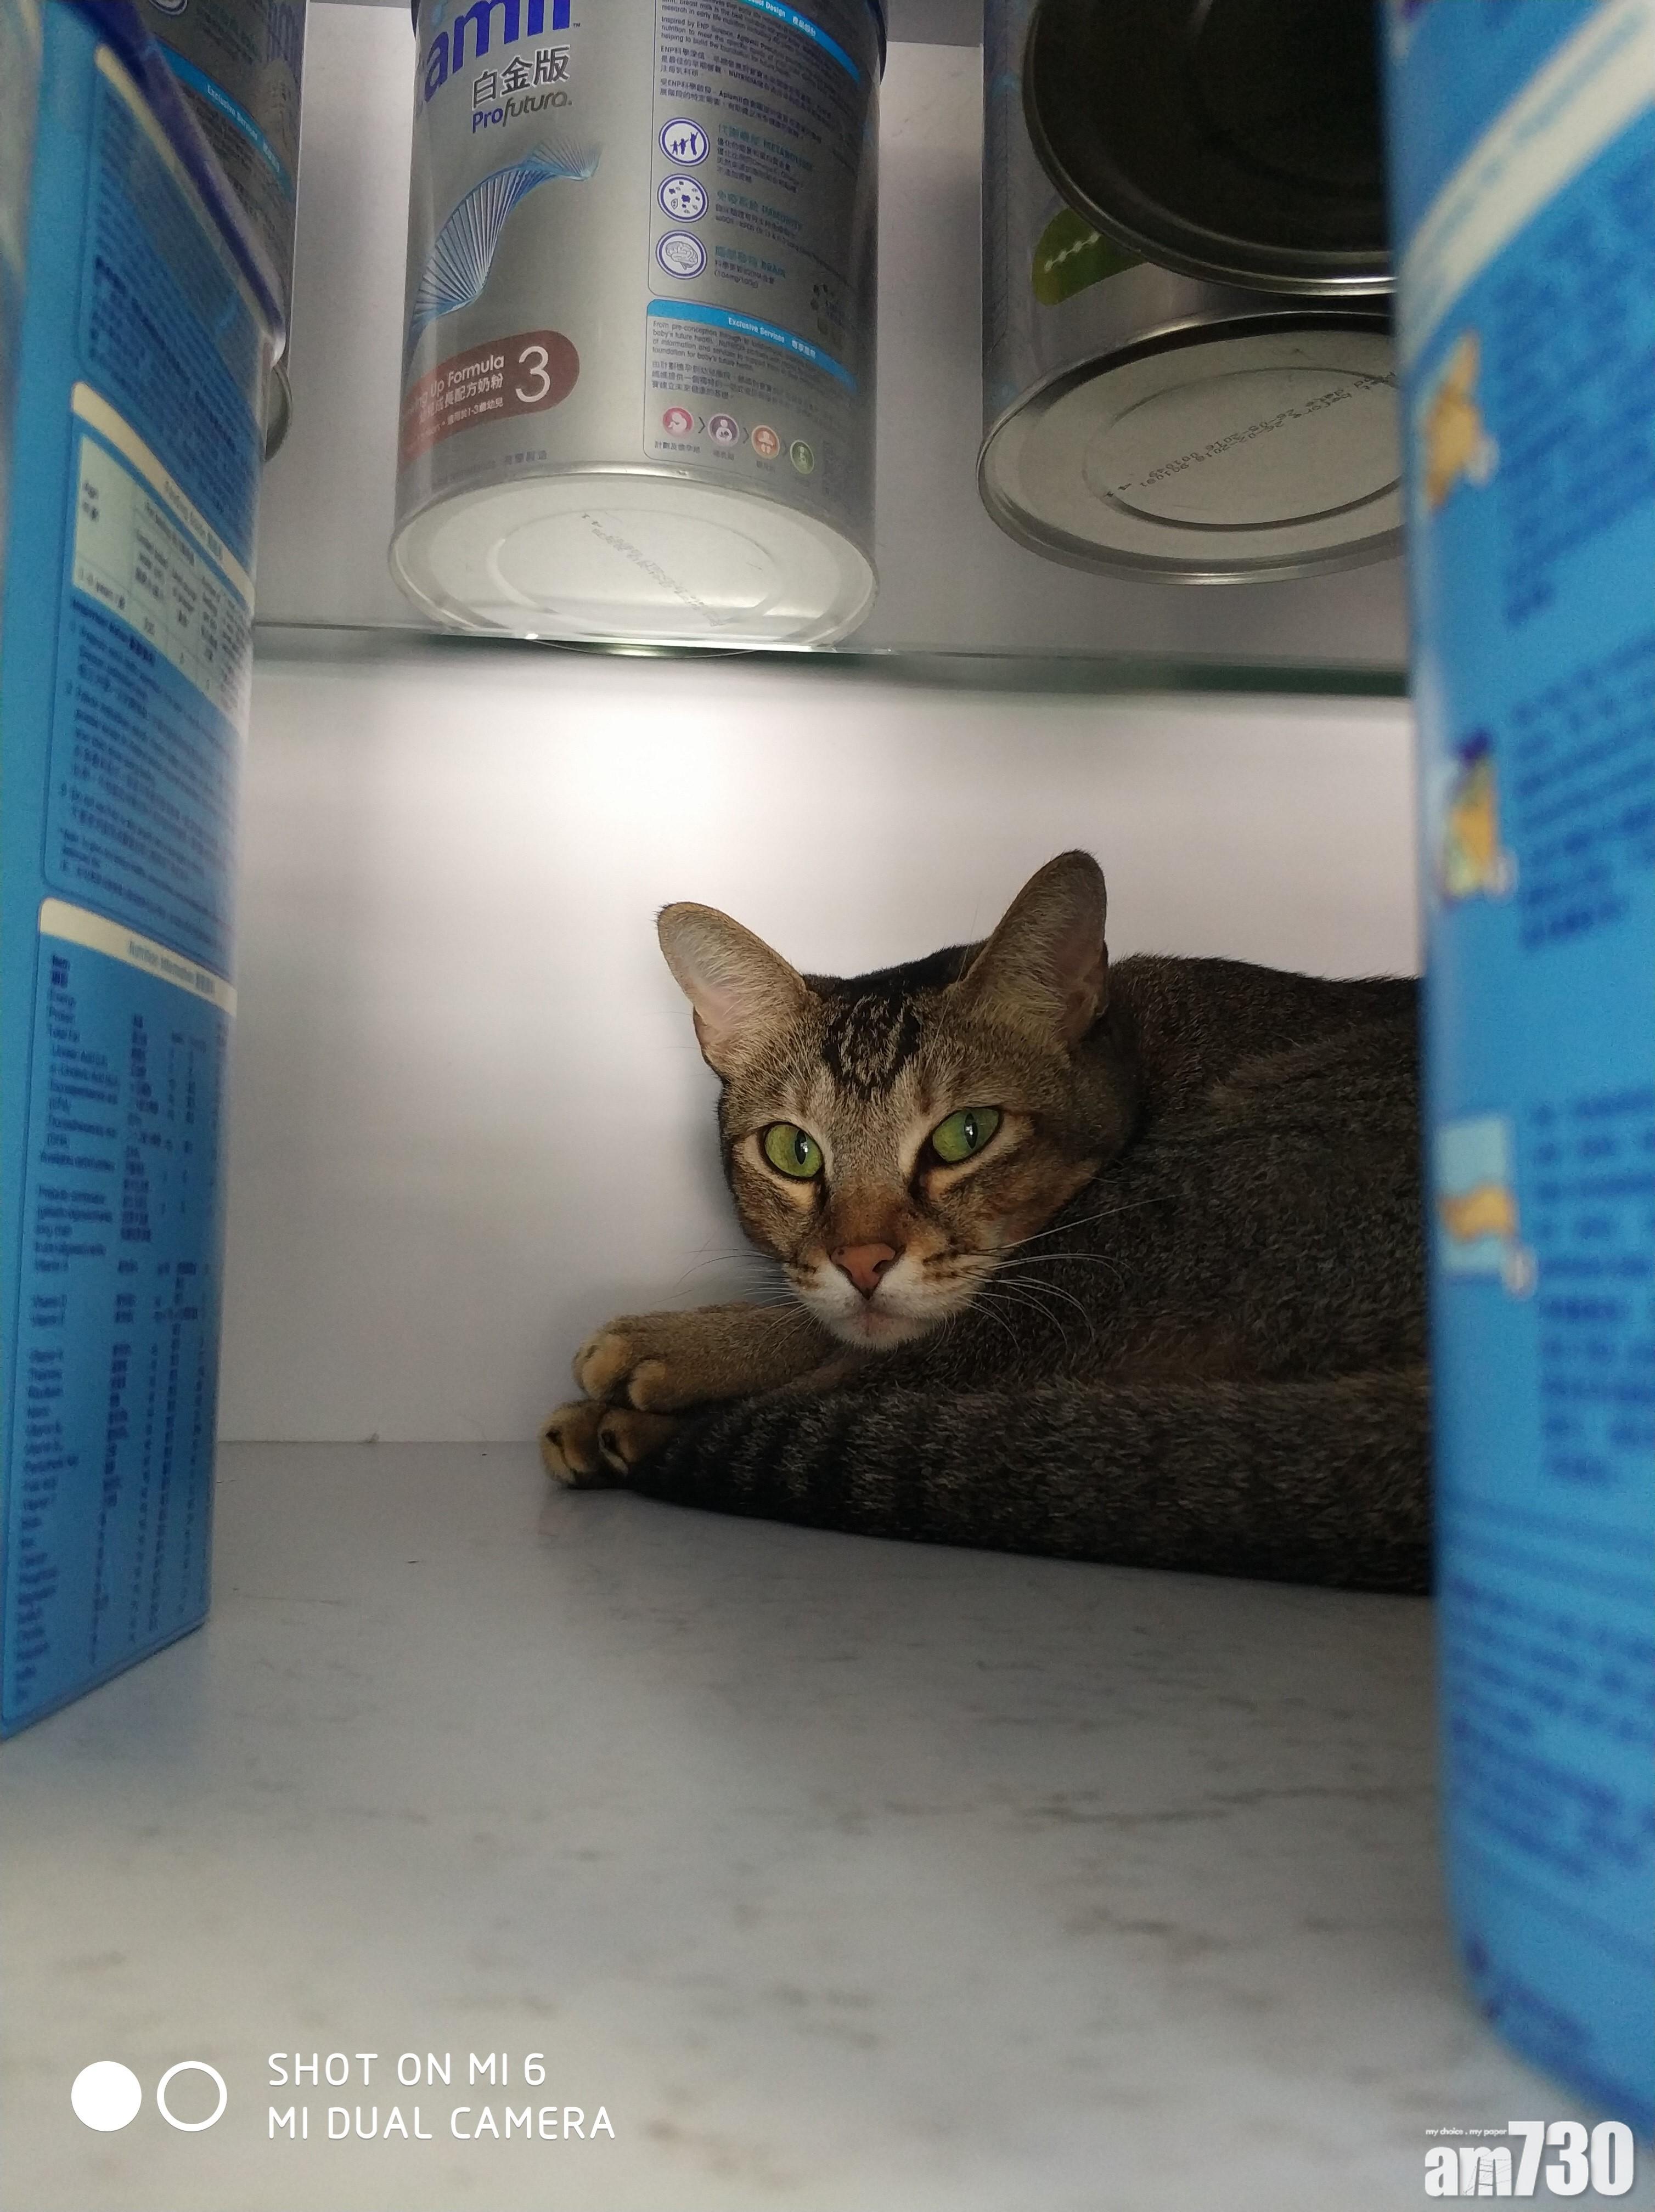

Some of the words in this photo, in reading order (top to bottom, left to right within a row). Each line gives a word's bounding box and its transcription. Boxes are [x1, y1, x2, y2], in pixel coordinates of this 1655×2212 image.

[661, 25, 686, 34] nutrition
[662, 16, 685, 26] Inspired
[688, 20, 695, 28] by
[661, 32, 684, 43] helping
[472, 44, 571, 111] 白金版
[653, 320, 669, 329] From
[672, 323, 717, 337] pre-conception
[653, 329, 674, 338] baby's
[675, 332, 693, 341] future
[728, 317, 759, 334] Exclusive
[759, 327, 785, 343] Services
[661, 339, 696, 350] information
[652, 346, 685, 357] foundation
[697, 352, 717, 362] baby's
[430, 379, 445, 398] Up
[448, 354, 505, 388] Formula
[515, 346, 551, 403] 3
